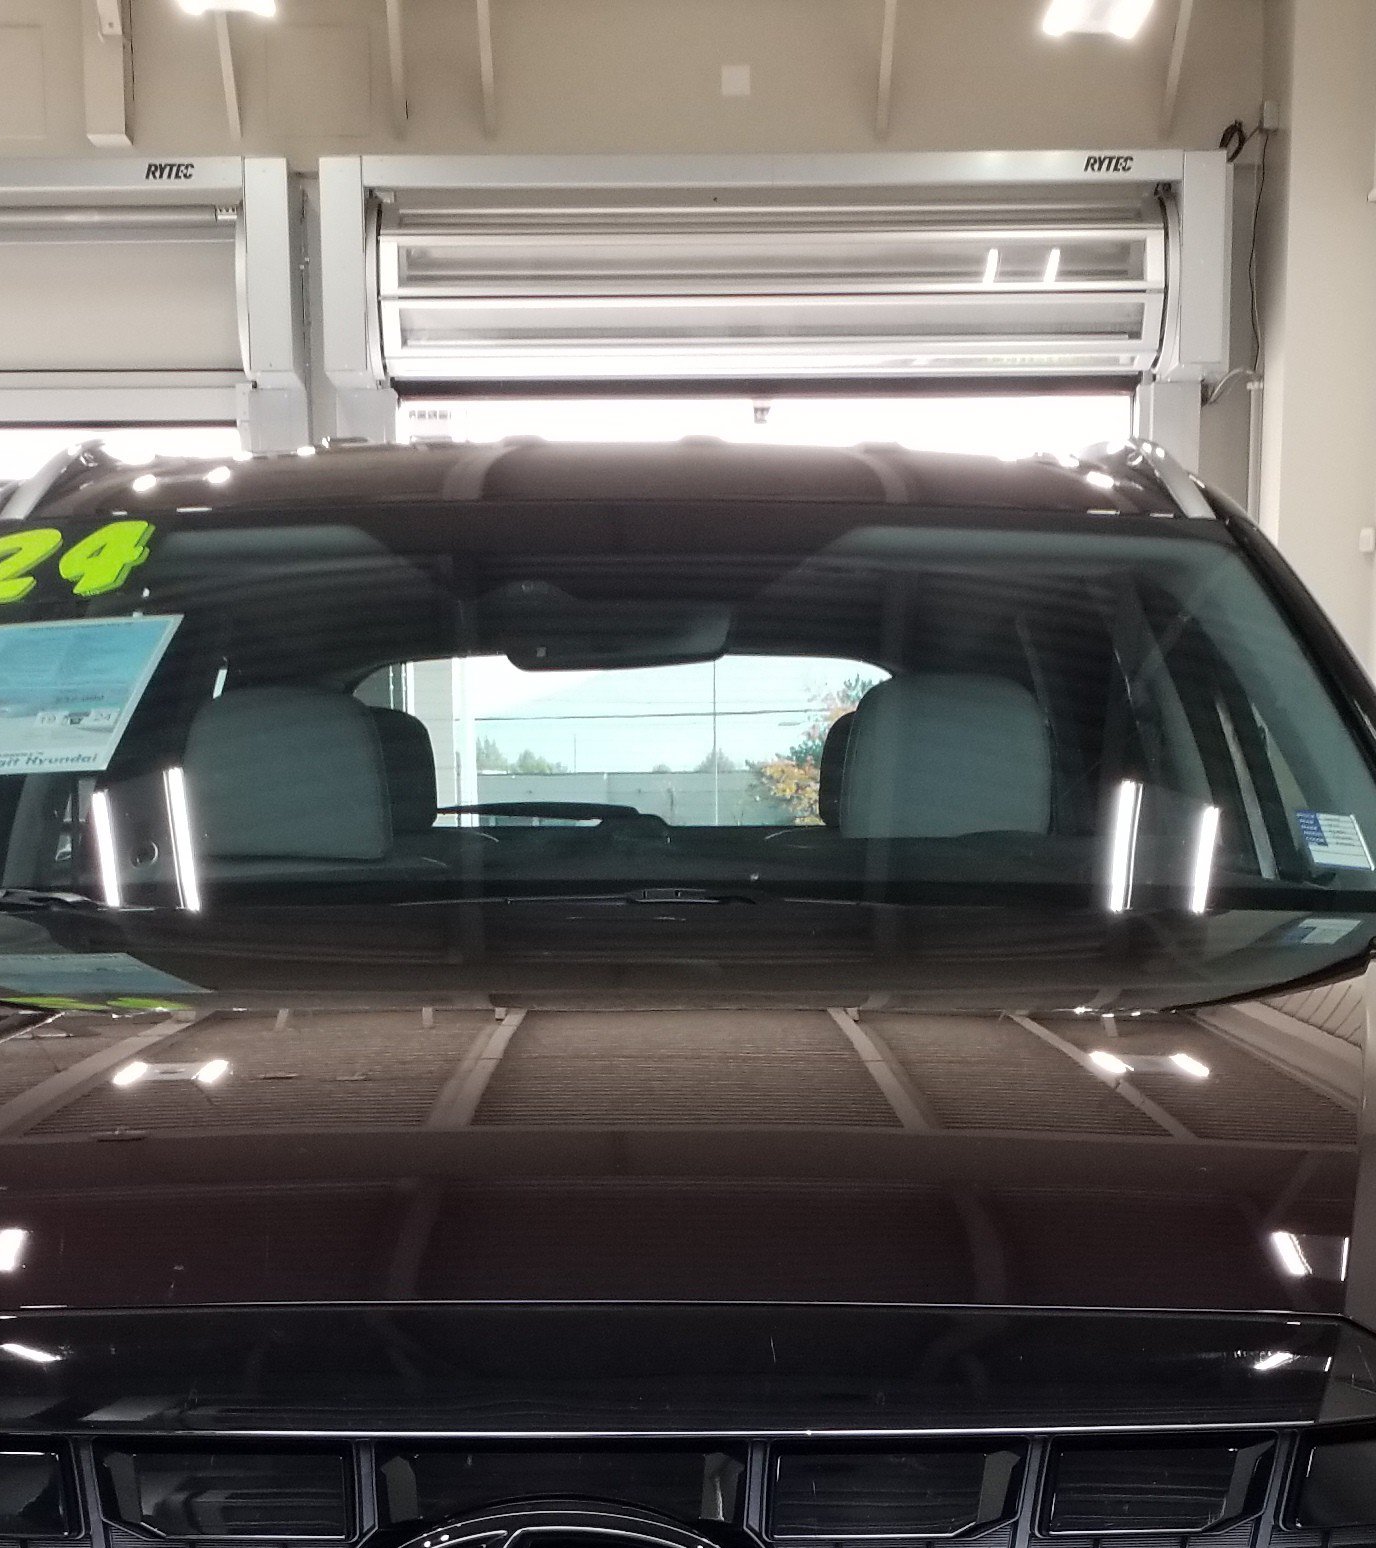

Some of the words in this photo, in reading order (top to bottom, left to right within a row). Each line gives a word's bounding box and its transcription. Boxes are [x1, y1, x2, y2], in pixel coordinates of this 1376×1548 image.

[145, 163, 195, 180] RYTEC
[1083, 155, 1134, 172] RYTEC
[25, 753, 98, 767] Hyundai
